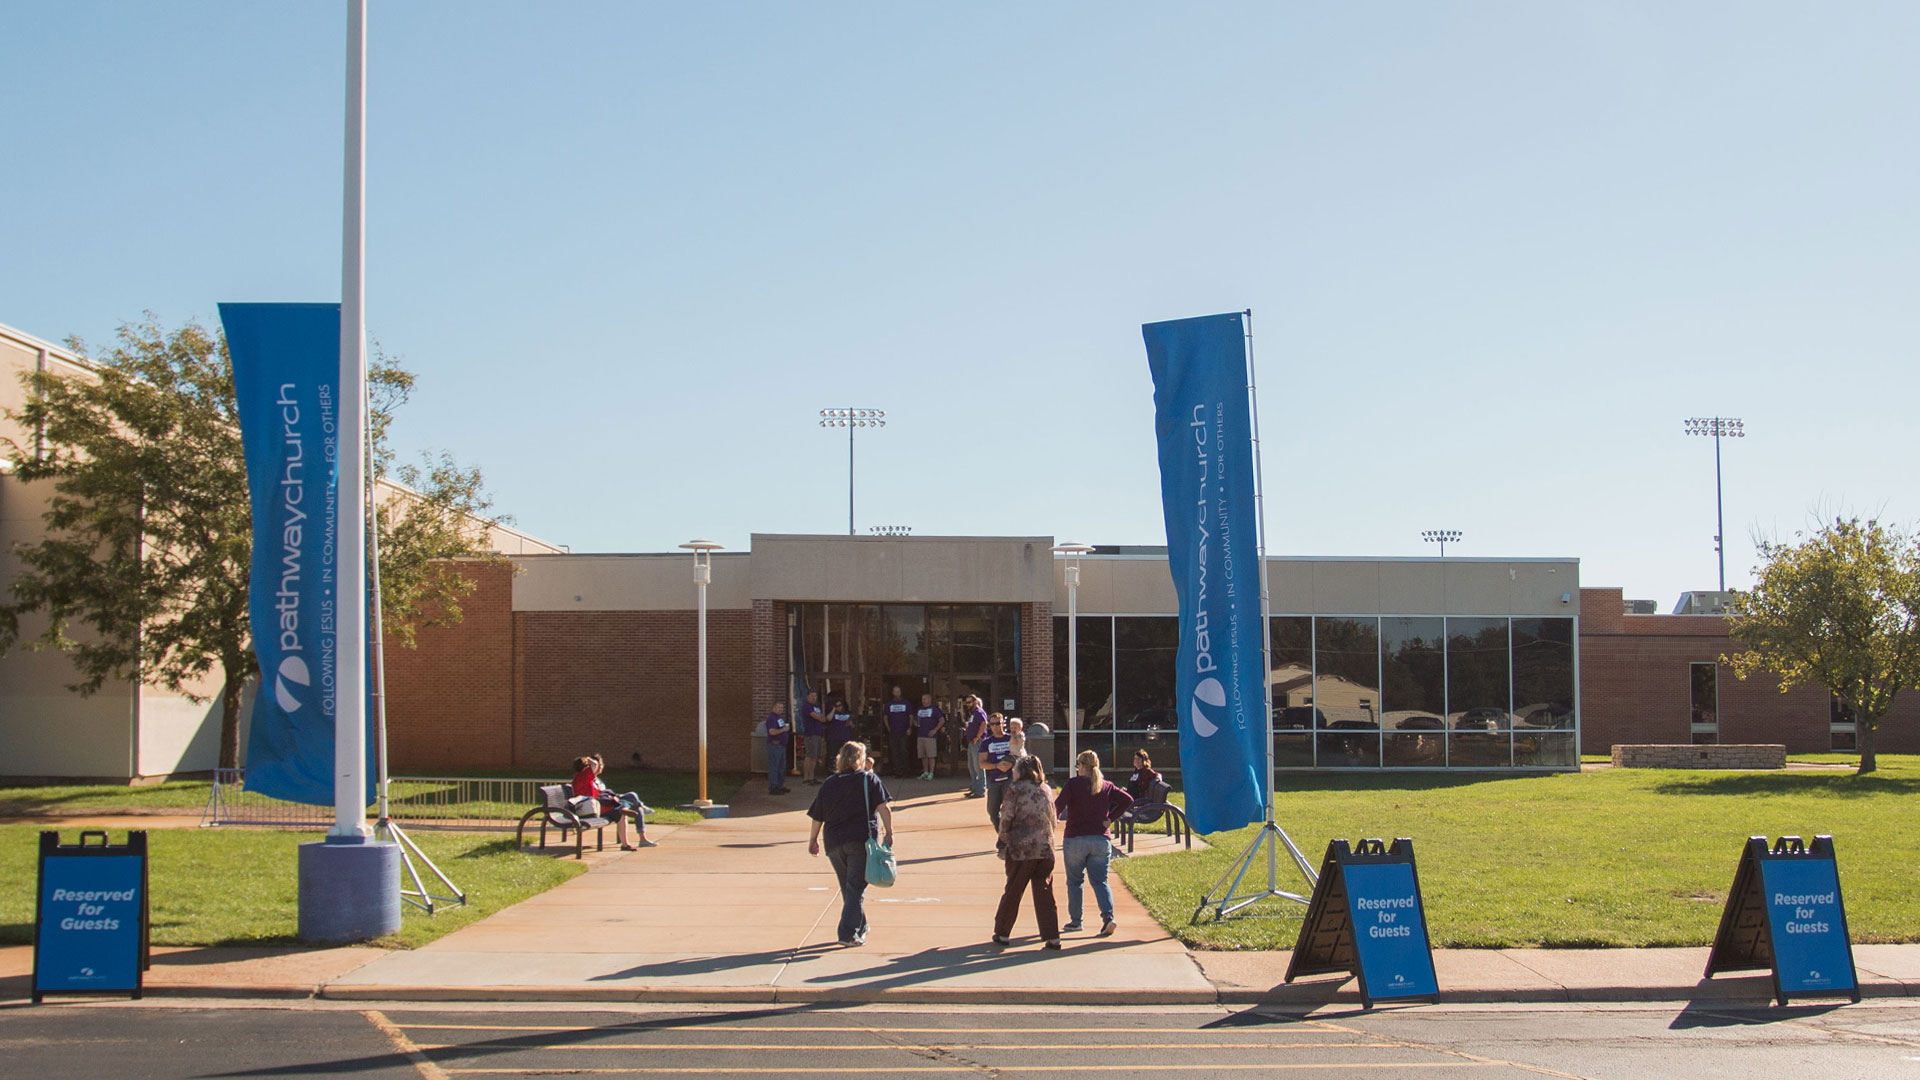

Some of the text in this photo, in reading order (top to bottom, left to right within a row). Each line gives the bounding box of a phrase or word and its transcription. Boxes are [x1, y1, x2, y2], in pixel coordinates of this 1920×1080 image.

[1216, 401, 1225, 451] OTHERS
[275, 383, 307, 651] pathwaychurch
[1190, 403, 1217, 674] pathwaychurch
[1218, 498, 1233, 580] COMMUNITY
[318, 383, 336, 716] FOLLOWING JESUS IN COMMUNITY FOR OTHERS
[1226, 583, 1235, 597] IN
[1230, 614, 1240, 649] JESUS
[1231, 652, 1246, 730] FOLLOWING
[52, 888, 136, 902] Reserved
[1357, 895, 1414, 910] Reserved
[1774, 891, 1835, 906] Reserved
[77, 902, 105, 916] for
[1795, 906, 1815, 920] for
[60, 917, 120, 931] Guests
[1378, 910, 1397, 924] for
[1369, 924, 1411, 938] Guests
[1785, 920, 1830, 934] Guests
